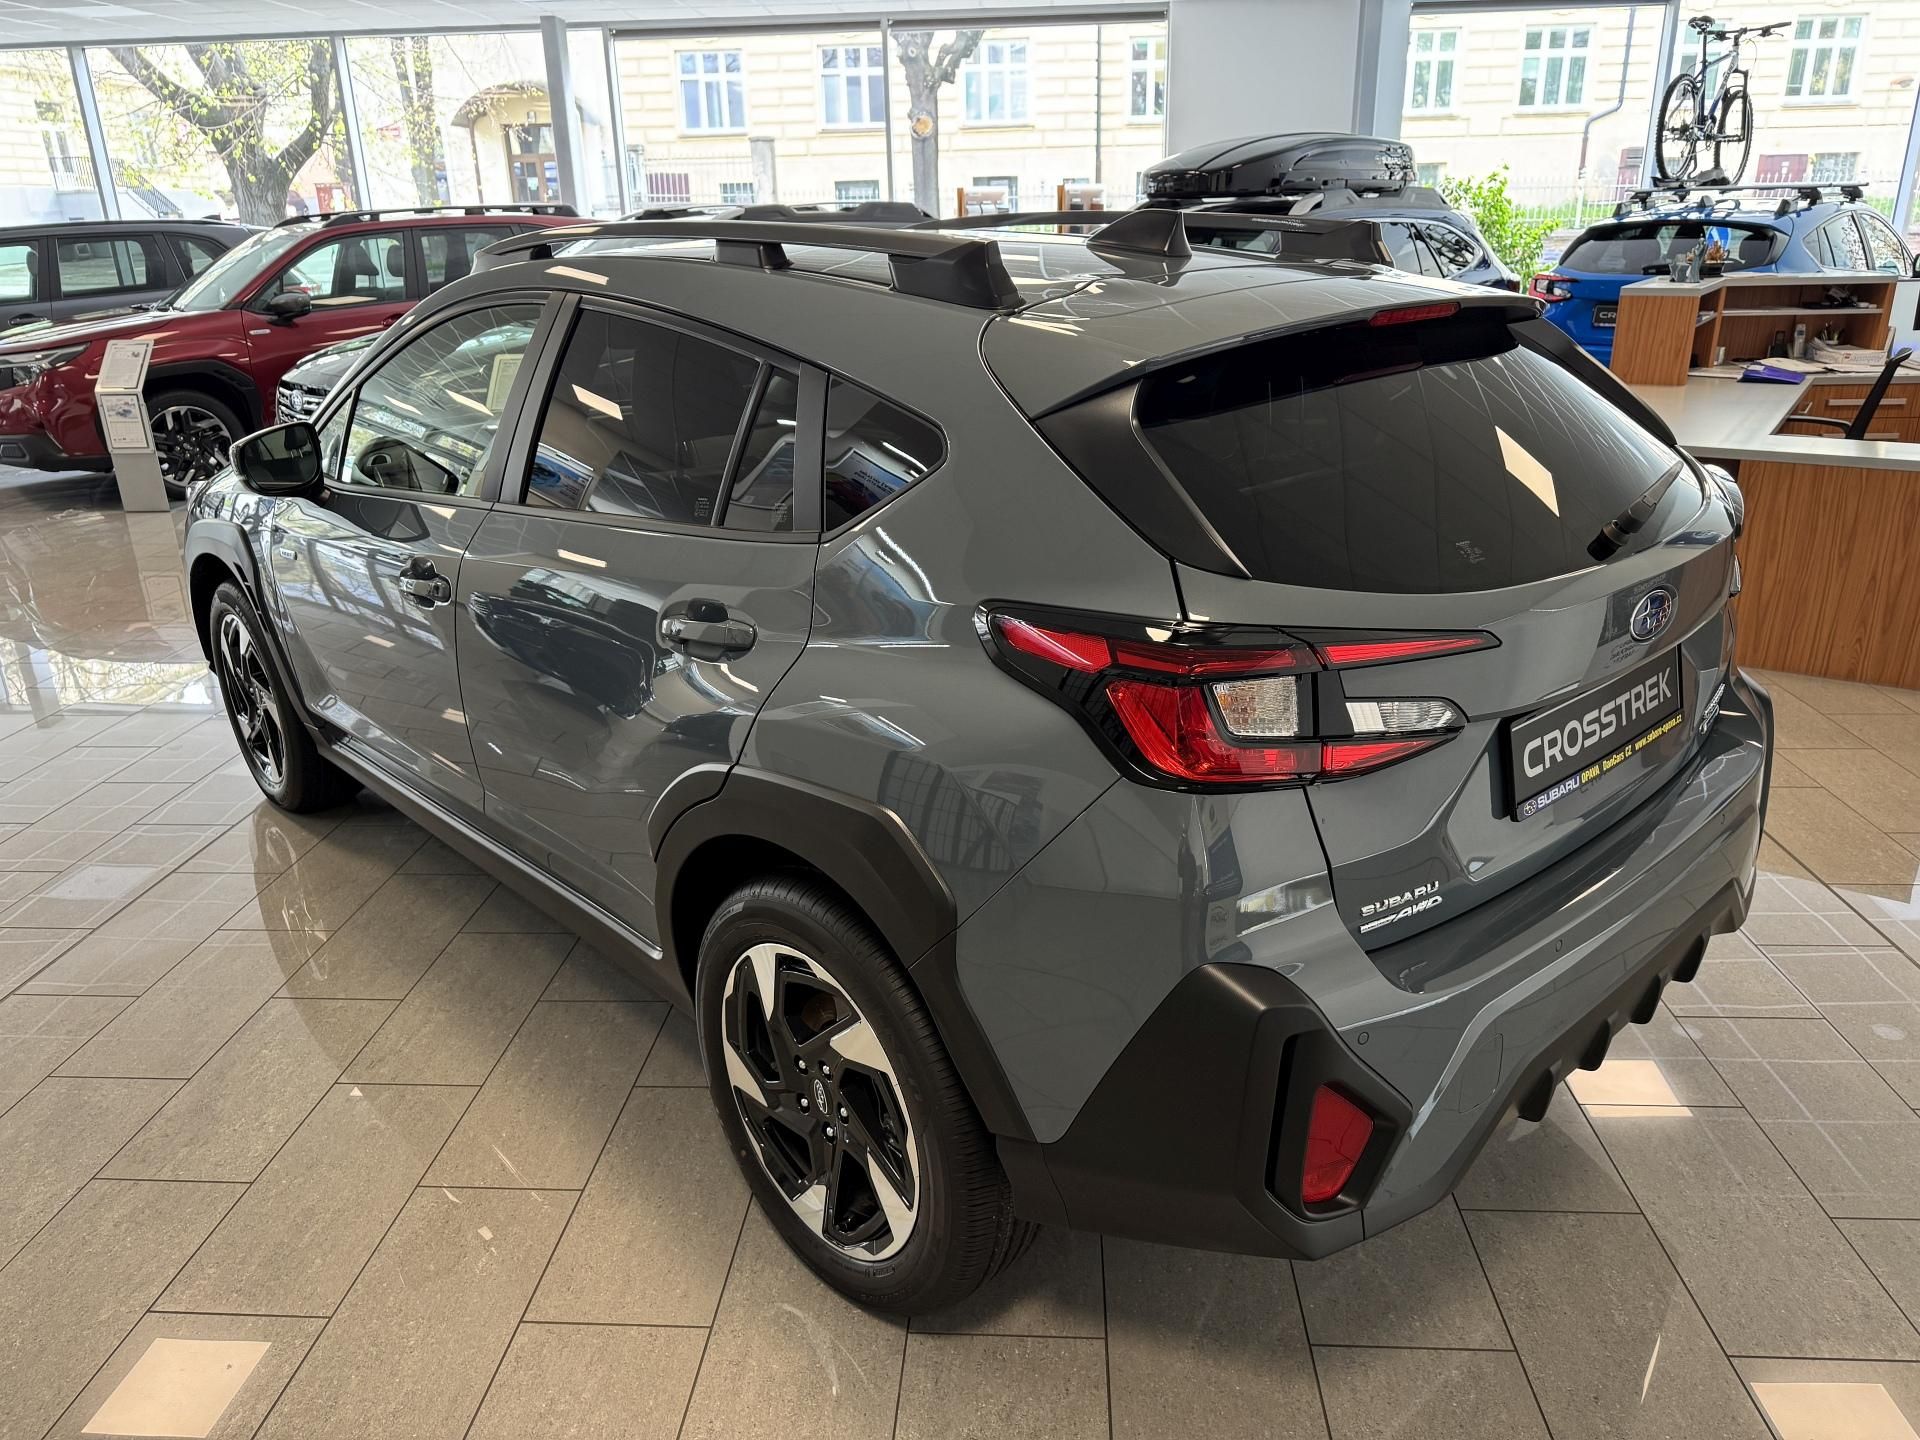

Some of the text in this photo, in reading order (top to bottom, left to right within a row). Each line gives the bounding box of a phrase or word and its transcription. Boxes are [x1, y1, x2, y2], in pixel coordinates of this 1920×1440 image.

[1523, 667, 1672, 779] CROSSTREK
[1537, 775, 1580, 809] SUBARU
[1581, 765, 1600, 784] OPAVA
[1625, 744, 1633, 757] CZ
[1361, 880, 1439, 917] SUBARU
[1393, 896, 1443, 923] AWD
